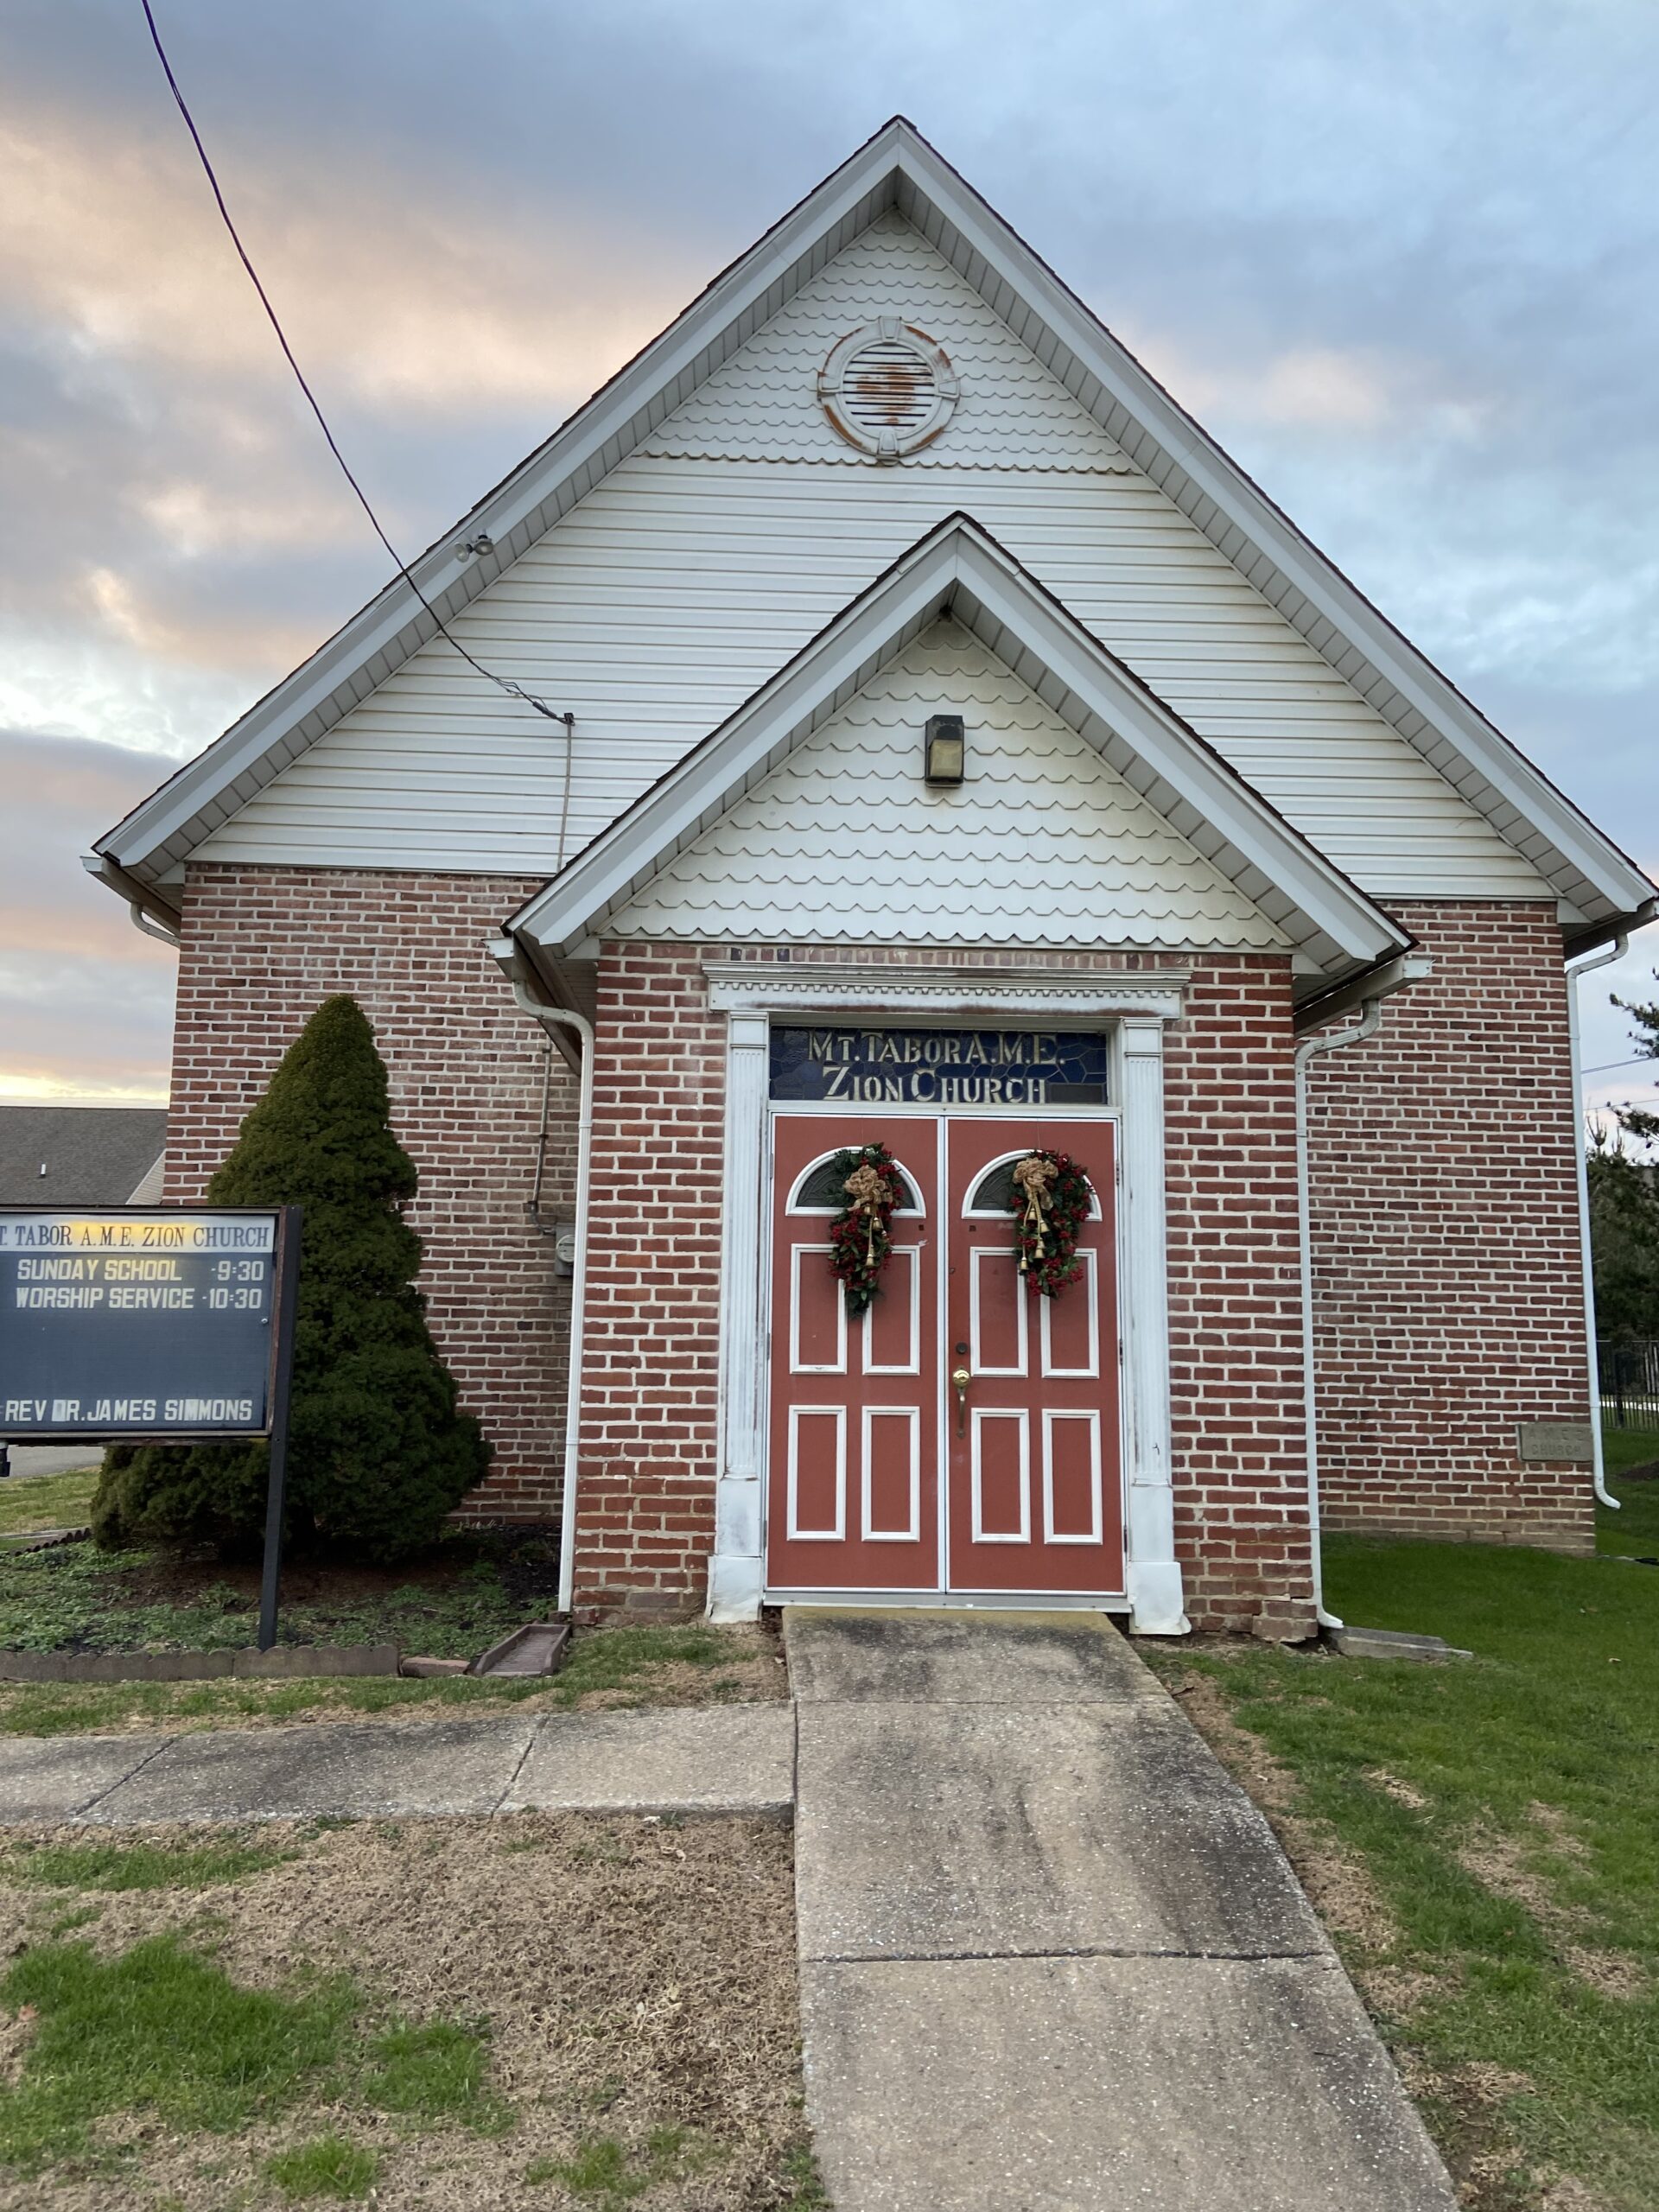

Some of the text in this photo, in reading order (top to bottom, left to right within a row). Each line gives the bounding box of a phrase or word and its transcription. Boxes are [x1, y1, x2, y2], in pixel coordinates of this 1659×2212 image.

[822, 1066, 1046, 1103] ZION CHURCH
[16, 1225, 73, 1246] TABOR
[80, 1225, 135, 1247] A.M.E.
[142, 1226, 186, 1247] ZION
[193, 1226, 270, 1248] CHURCH
[17, 1259, 99, 1281] SUNDAY
[104, 1259, 182, 1281] SCHOOL
[16, 1287, 104, 1309] WORSHIP
[109, 1287, 195, 1309] SERVICE
[4, 1400, 48, 1421] REV
[164, 1398, 253, 1421] SIMMONS
